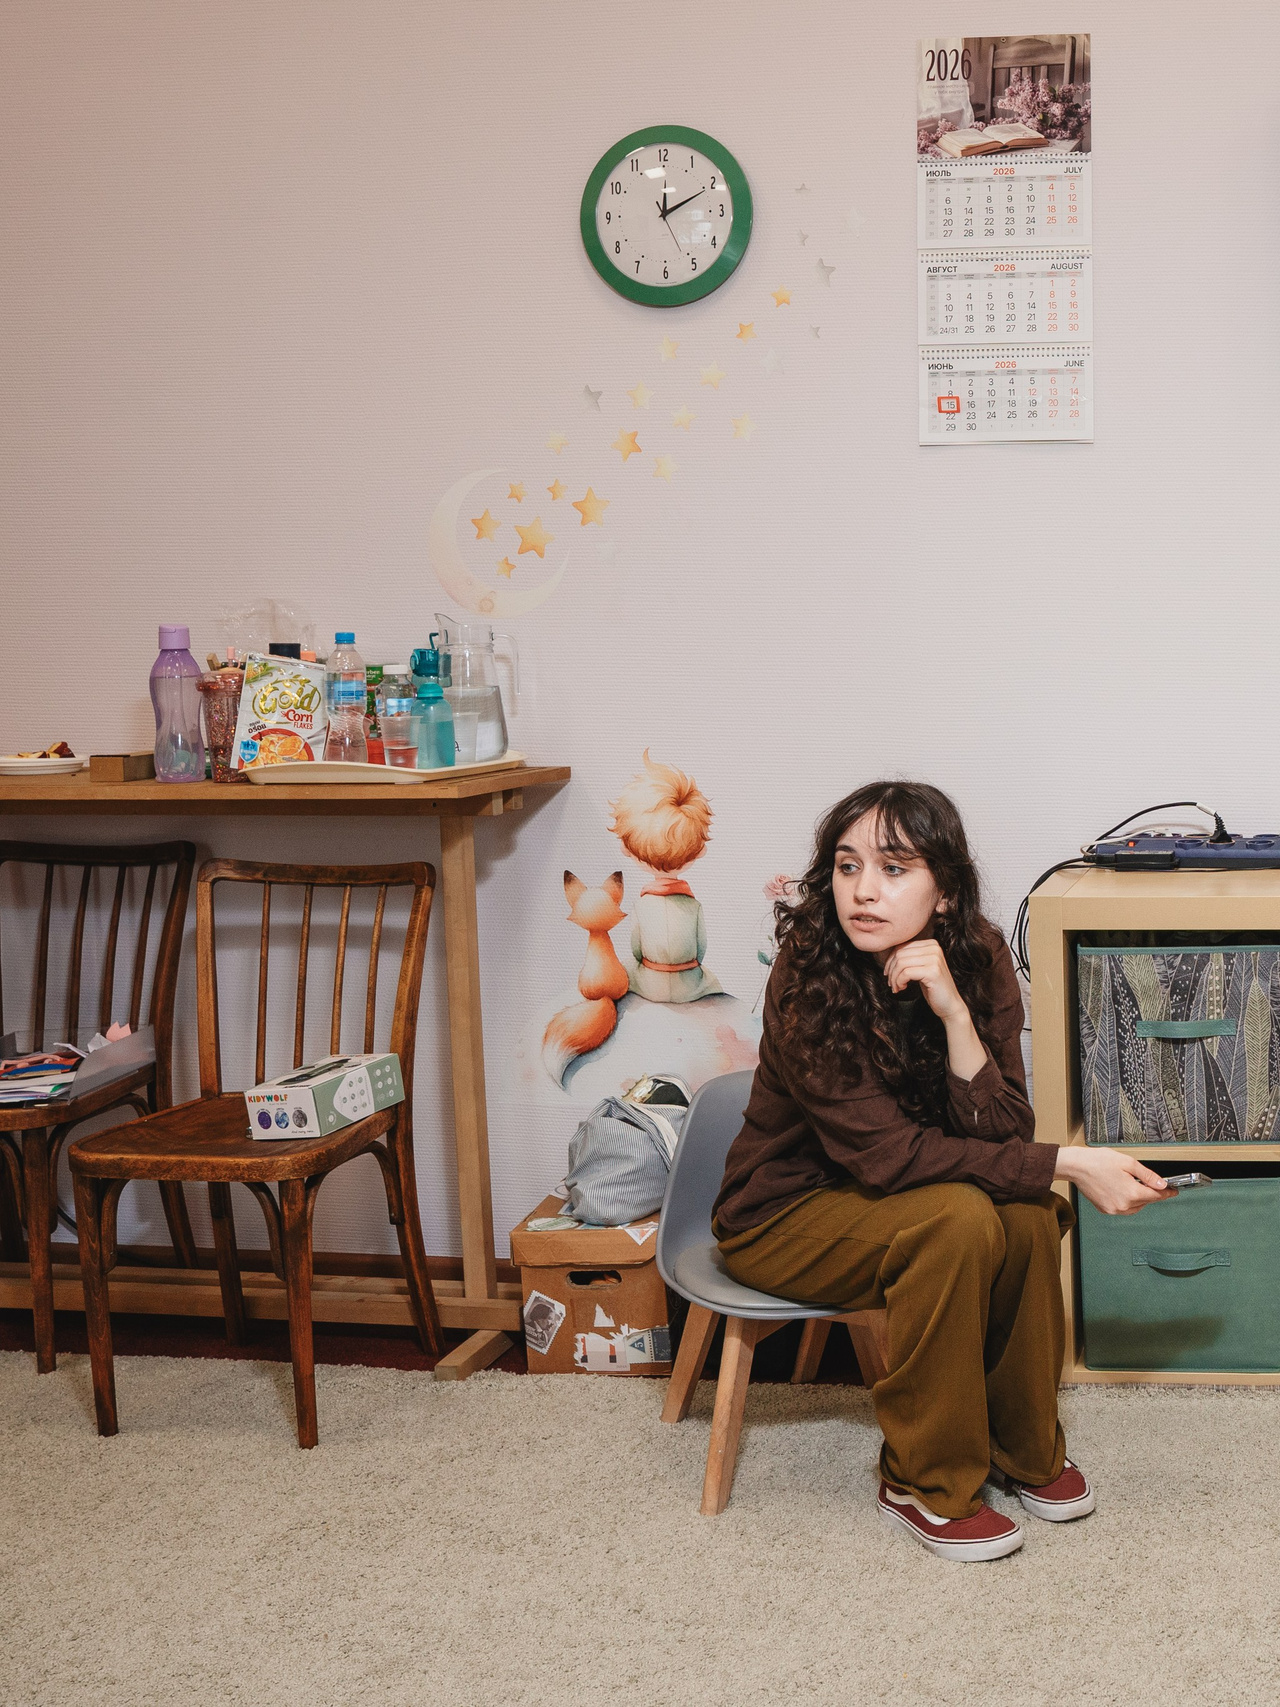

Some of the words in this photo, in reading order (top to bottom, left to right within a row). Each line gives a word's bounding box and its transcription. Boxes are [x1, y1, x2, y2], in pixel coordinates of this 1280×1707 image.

[925, 49, 972, 82] 2026
[658, 149, 669, 162] 12
[630, 159, 639, 172] 11
[690, 156, 694, 169] 1
[1063, 166, 1083, 174] JULY
[610, 182, 622, 195] 10
[710, 177, 716, 190] 2
[1026, 194, 1036, 202] 10
[1048, 194, 1055, 202] 11
[1068, 194, 1077, 202] 12
[719, 204, 725, 217] 3
[944, 208, 952, 216] 13
[964, 207, 973, 215] 14
[985, 206, 994, 214] 15
[1006, 206, 1015, 214] 16
[1047, 205, 1056, 213] 18
[1068, 204, 1077, 212] 19
[605, 211, 611, 224] 9
[943, 218, 954, 226] 20
[964, 218, 973, 226] 21
[984, 218, 994, 226] 22
[1005, 217, 1015, 225] 23
[1046, 216, 1057, 224] 25
[1067, 216, 1078, 224] 26
[943, 230, 953, 238] 27
[964, 229, 974, 237] 28
[984, 228, 994, 236] 29
[1004, 228, 1016, 236] 30
[1026, 228, 1035, 236] 31
[615, 241, 621, 254] 8
[711, 235, 717, 249] 4
[635, 261, 641, 274] 7
[691, 258, 697, 271] 5
[926, 265, 958, 273] АВГУСТ
[1050, 262, 1083, 270] AUGUST
[663, 266, 669, 279] 6
[945, 304, 954, 312] 10
[985, 303, 995, 311] 12
[1007, 302, 1016, 310] 13
[1048, 301, 1057, 310] 15
[1069, 301, 1078, 309] 16
[944, 315, 954, 323] 17
[965, 314, 974, 322] 18
[986, 314, 995, 322] 19
[1006, 313, 1016, 322] 20
[1027, 313, 1036, 321] 21
[1047, 312, 1058, 320] 22
[1068, 312, 1079, 320] 23
[964, 326, 975, 334] 25
[985, 325, 996, 333] 26
[1006, 324, 1016, 332] 27
[1026, 324, 1037, 332] 28
[1048, 324, 1058, 332] 29
[1068, 323, 1079, 332] 30
[987, 389, 996, 397] 10
[1008, 388, 1015, 396] 11
[1028, 388, 1037, 396] 12
[1049, 388, 1058, 396] 13
[946, 401, 955, 409] 15
[987, 400, 996, 408] 17
[1008, 400, 1016, 408] 18
[1028, 399, 1037, 407] 19
[1048, 398, 1059, 407] 20
[1070, 398, 1078, 406] 21
[966, 412, 976, 420] 23
[987, 411, 996, 419] 24
[1007, 410, 1017, 418] 25
[1027, 410, 1038, 418] 26
[1048, 410, 1058, 418] 27
[1069, 410, 1080, 418] 28
[946, 423, 956, 431] 29
[966, 422, 977, 431] 30
[258, 683, 318, 715] Gold
[285, 709, 313, 723] Corn
[293, 721, 314, 730] FLAKES
[247, 1094, 288, 1103] KIDYWOLF
